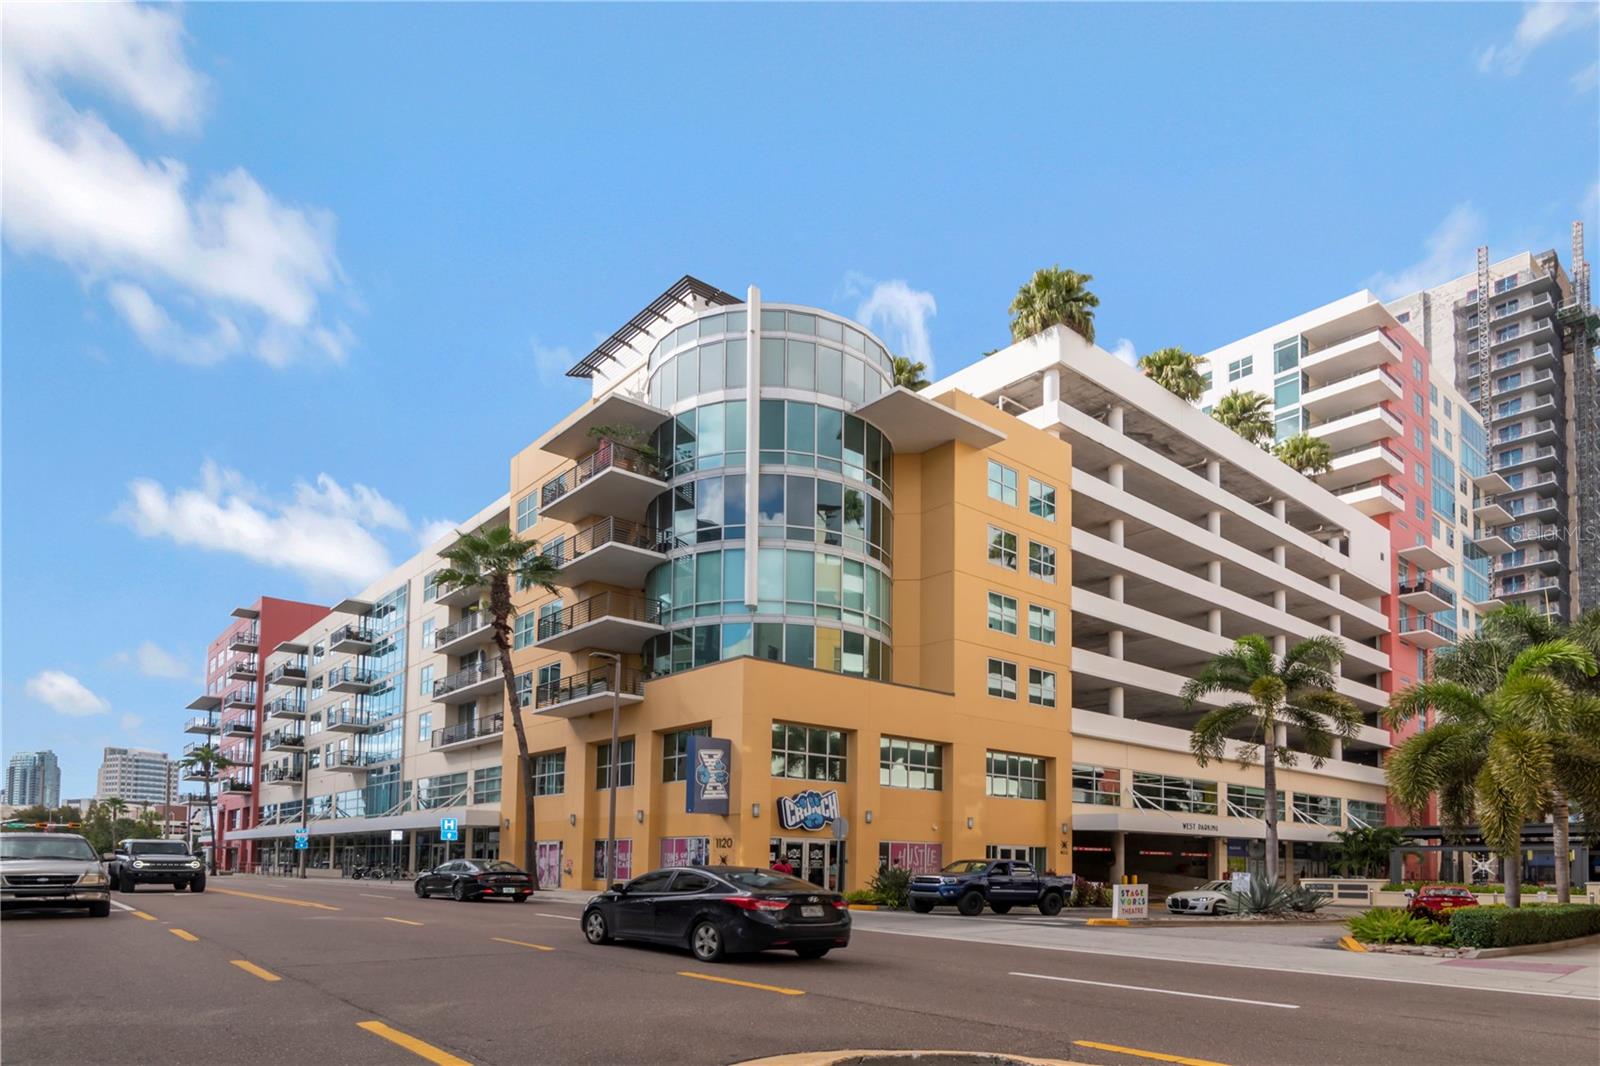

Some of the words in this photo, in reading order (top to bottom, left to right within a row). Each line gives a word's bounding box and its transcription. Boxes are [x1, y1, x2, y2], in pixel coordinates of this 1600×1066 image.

[444, 820, 455, 830] H
[715, 838, 733, 848] 1120
[898, 845, 938, 867] HUSTLE
[1121, 889, 1145, 897] STAGE
